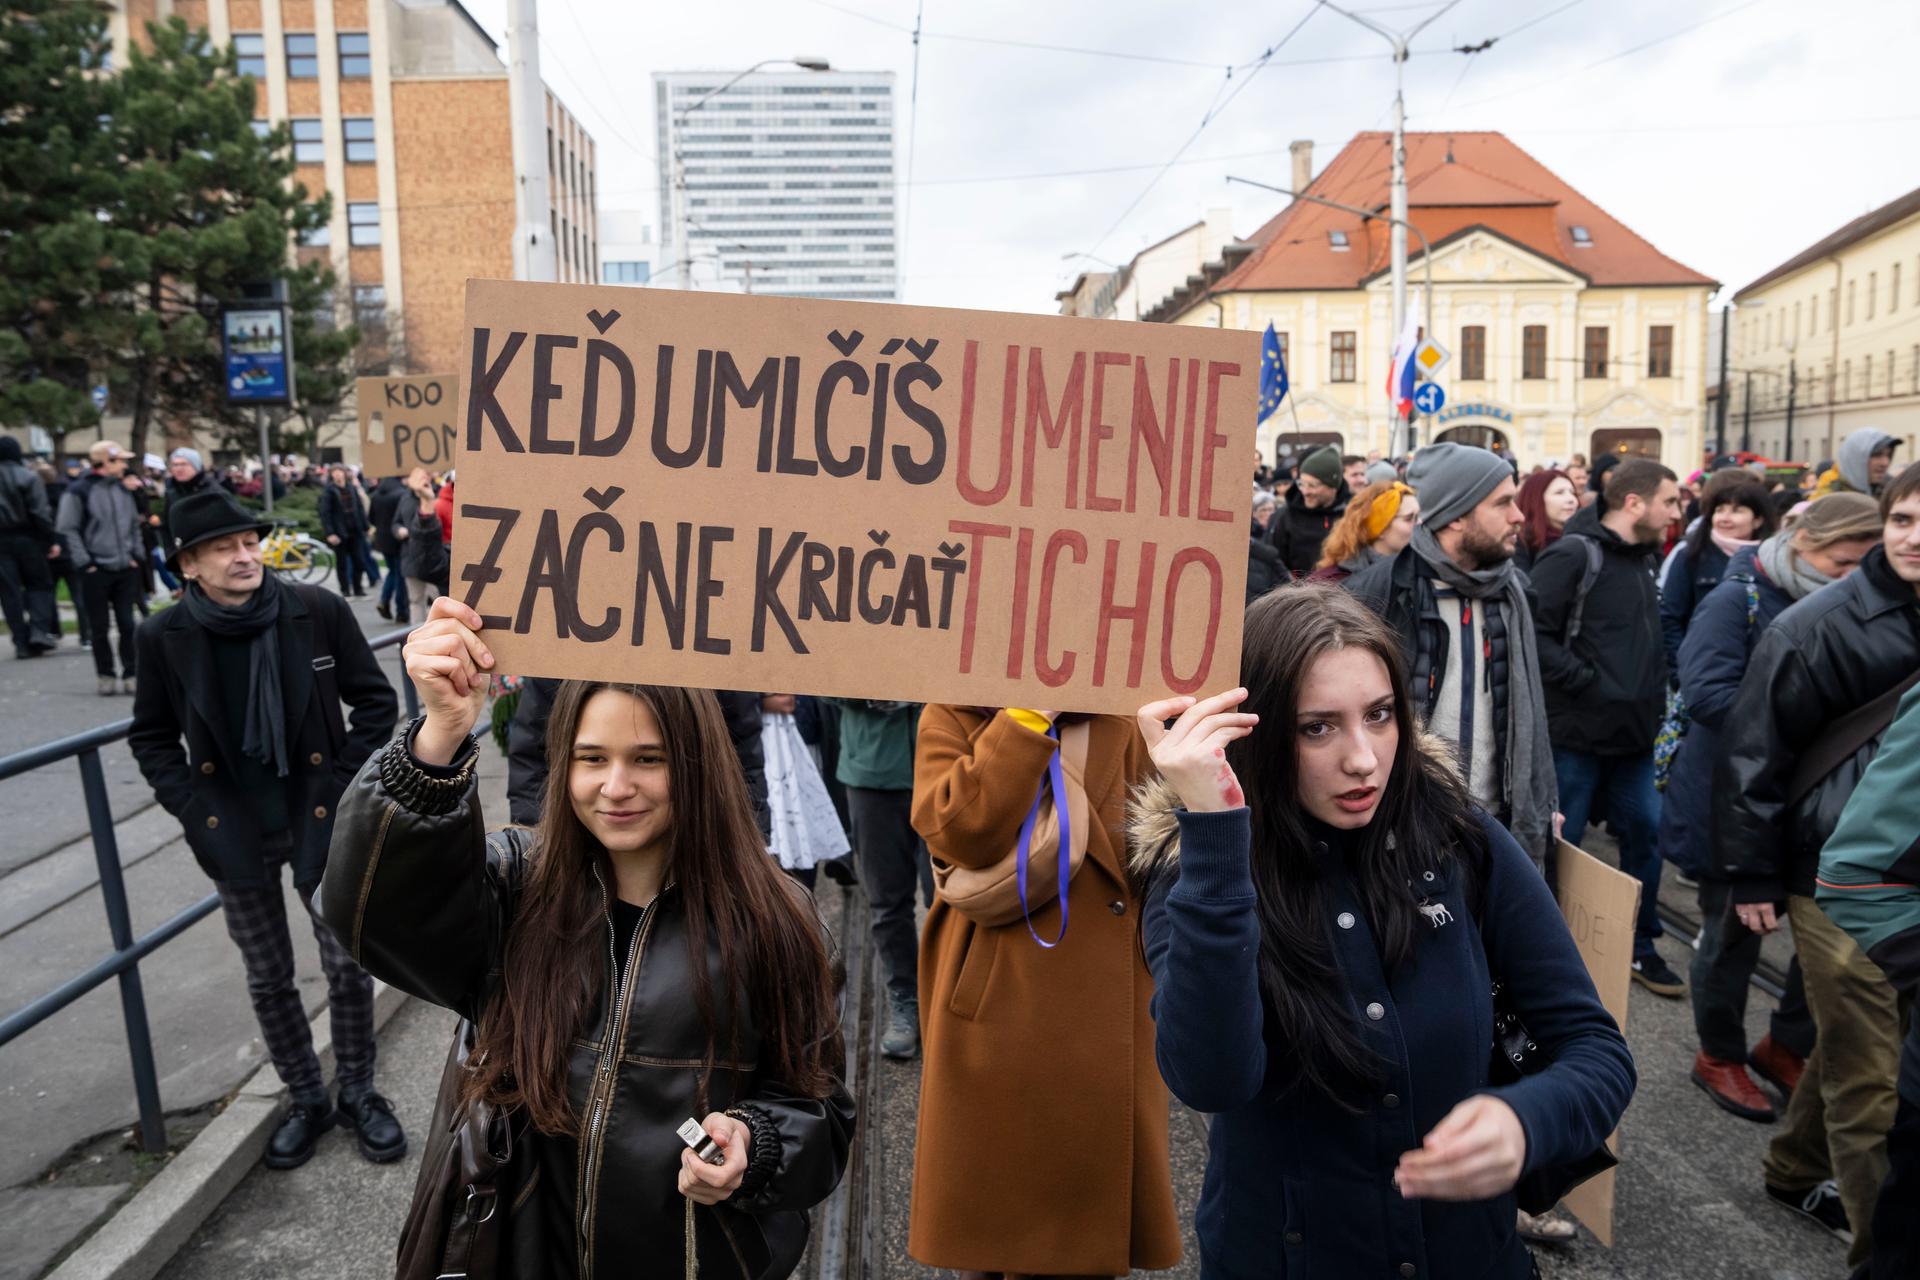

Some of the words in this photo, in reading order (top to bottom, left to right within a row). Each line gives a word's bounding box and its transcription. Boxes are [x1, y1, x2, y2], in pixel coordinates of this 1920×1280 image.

[384, 382, 442, 409] KDO
[467, 309, 636, 457] KEĎ
[651, 329, 947, 485] UMLČÍŠ
[956, 339, 1241, 523] UMENIE
[461, 486, 734, 655] ZAČNE
[751, 528, 966, 654] KRIČAŤ
[949, 520, 1223, 694] TICHO
